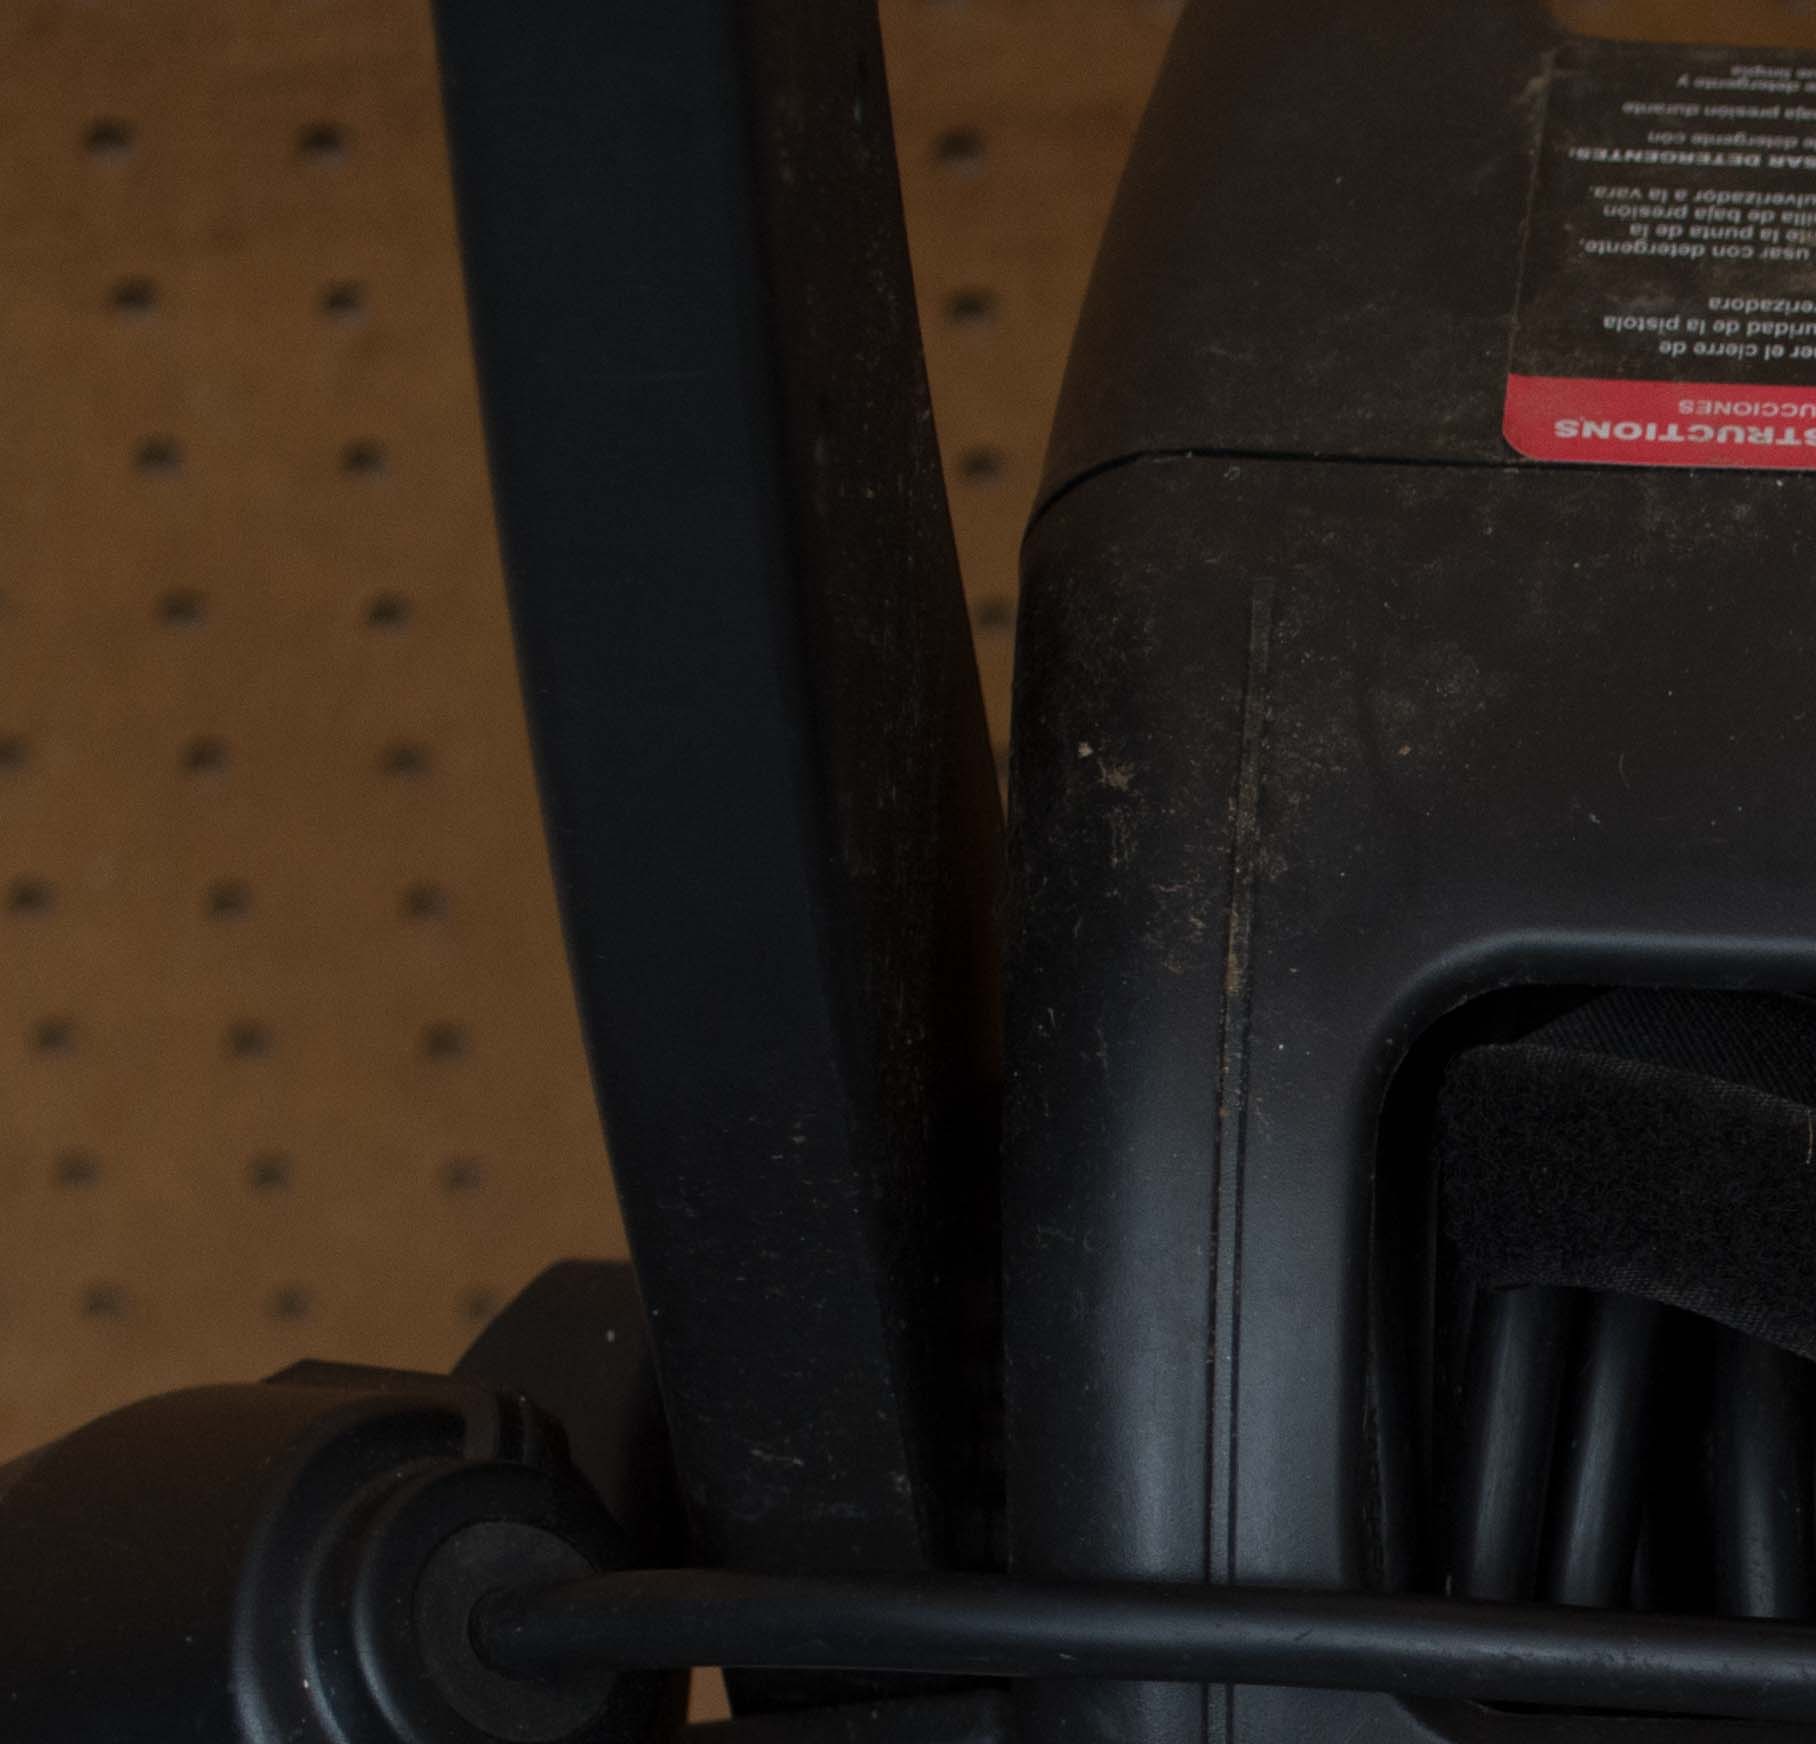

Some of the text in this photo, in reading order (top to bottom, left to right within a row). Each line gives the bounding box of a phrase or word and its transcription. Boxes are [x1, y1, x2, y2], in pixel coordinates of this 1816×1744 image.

[1570, 148, 1761, 167] DETERGENTES:
[1590, 186, 1643, 199] vara.
[1648, 188, 1668, 204] la
[1674, 189, 1688, 202] a
[1603, 204, 1689, 227] presión
[1694, 205, 1742, 224] baja
[1747, 209, 1776, 228] de
[1629, 223, 1650, 242] la
[1655, 224, 1684, 240] de
[1689, 224, 1754, 240] punta
[1759, 228, 1780, 244] la
[1711, 245, 1755, 260] con
[1759, 246, 1810, 262] usar
[1603, 315, 1681, 334] pistola
[1686, 318, 1706, 335] la
[1712, 319, 1741, 336] de
[1658, 340, 1687, 357] de
[1693, 341, 1758, 359] cierre
[1764, 344, 1785, 361] el
